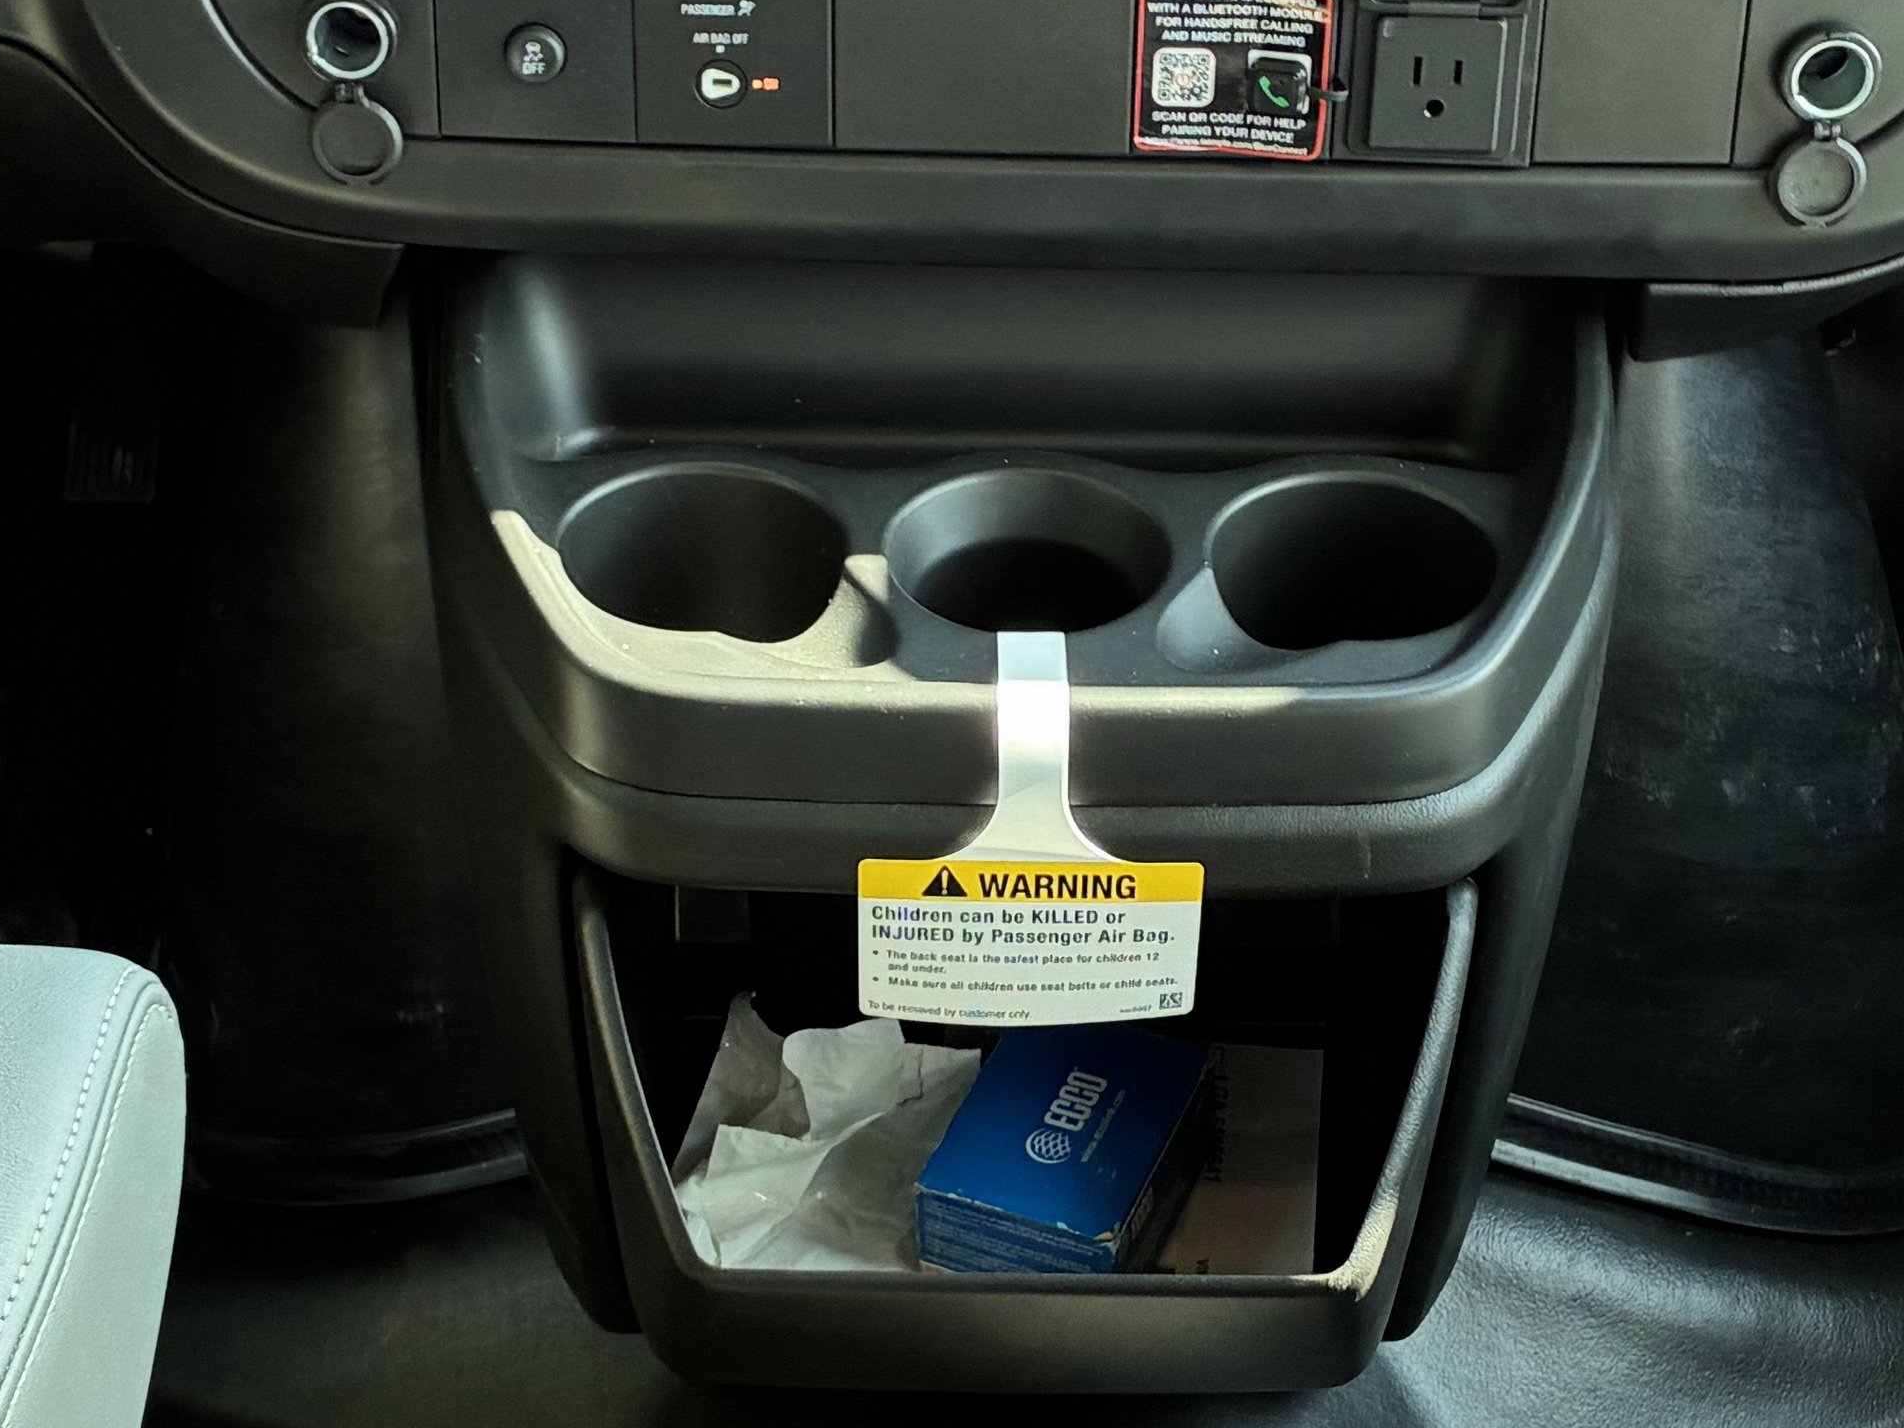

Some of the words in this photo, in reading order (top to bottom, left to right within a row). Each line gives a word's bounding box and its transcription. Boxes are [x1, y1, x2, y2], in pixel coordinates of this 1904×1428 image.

[1147, 2, 1179, 14] WITH
[1182, 3, 1191, 15] A
[1192, 3, 1268, 18] BLUETOOTH
[1155, 16, 1181, 28] FOR
[1184, 16, 1258, 30] HANDSFREE
[1260, 20, 1314, 35] CALLING
[1161, 29, 1189, 42] AND
[1191, 29, 1232, 43] MUSIC
[1233, 31, 1306, 48] STREAMING
[522, 60, 545, 74] OFF
[1151, 111, 1187, 124] SCAN
[1209, 112, 1245, 125] CODE
[1246, 114, 1272, 127] FOR
[1273, 116, 1306, 131] HELP
[1161, 124, 1213, 137] PAIRING
[1214, 125, 1250, 140] YOUR
[1251, 128, 1295, 144] DEVICE
[978, 872, 1137, 899] WARNING
[871, 905, 953, 923] Children
[959, 909, 995, 924] can
[1002, 908, 1025, 924] be
[1031, 910, 1099, 924] KILLED
[1106, 912, 1127, 925] or
[871, 925, 954, 943] INJURED
[962, 927, 984, 947] by
[991, 929, 1093, 947] Passenger
[1097, 929, 1126, 943] Air
[1132, 928, 1177, 947] Bag.
[886, 948, 907, 960] The
[910, 950, 937, 962] back
[941, 952, 966, 963] seat
[982, 953, 1001, 964] the
[1003, 953, 1038, 964] safest
[1042, 954, 1074, 966] place
[1076, 953, 1093, 964] for
[1096, 952, 1142, 963] children
[1146, 951, 1160, 962] 12
[887, 962, 909, 972] and
[911, 963, 948, 974] under.
[888, 976, 919, 987] Make
[922, 978, 947, 989] sure
[967, 980, 1014, 992] children
[1016, 982, 1038, 992] use
[1041, 981, 1065, 992] seat
[1099, 981, 1111, 990] or
[1114, 978, 1142, 990] child
[1145, 976, 1179, 987] seats.
[867, 999, 880, 1009] To
[882, 1001, 895, 1011] be
[944, 1006, 957, 1018] by
[1043, 1070, 1109, 1133] ECCO
